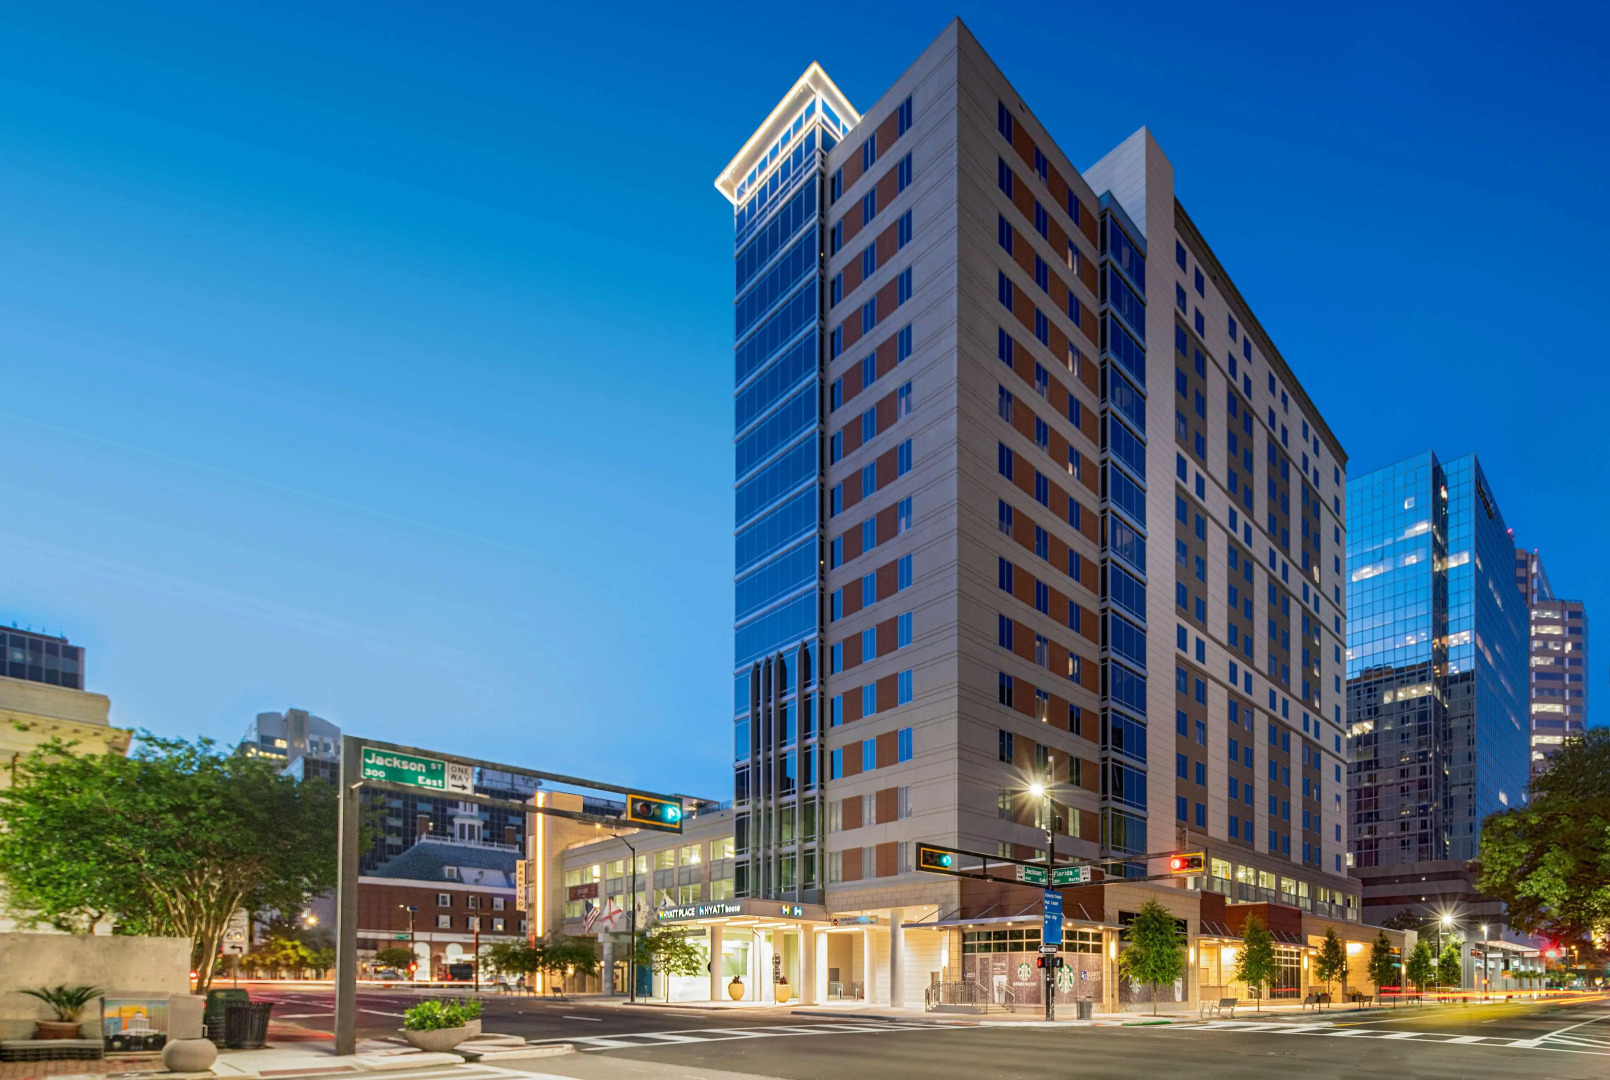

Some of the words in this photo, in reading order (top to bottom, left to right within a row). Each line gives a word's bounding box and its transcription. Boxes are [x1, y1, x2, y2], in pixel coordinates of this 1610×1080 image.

[365, 753, 426, 773] Jackson
[430, 762, 442, 771] ST
[364, 768, 386, 778] 300
[450, 765, 470, 775] ONE
[417, 775, 443, 788] East
[450, 773, 470, 783] WAY
[1025, 868, 1042, 876] Jackson
[664, 908, 679, 918] HYATT
[678, 907, 695, 917] PLACE
[704, 904, 725, 915] HYATT
